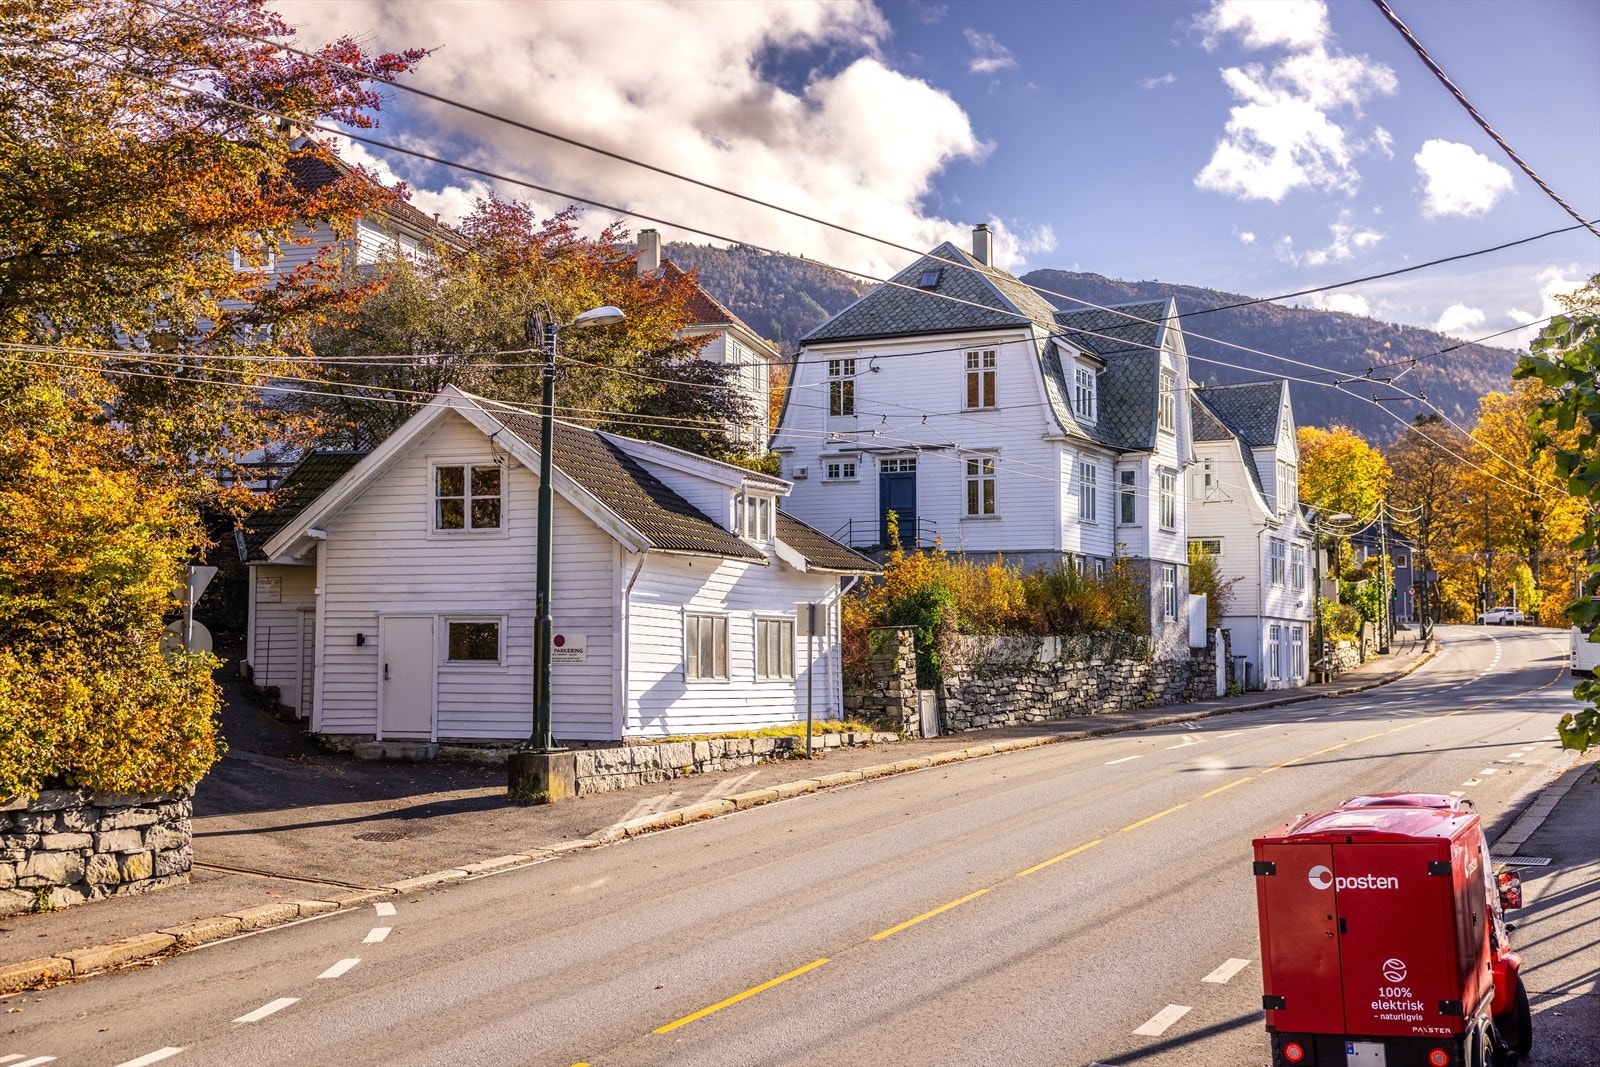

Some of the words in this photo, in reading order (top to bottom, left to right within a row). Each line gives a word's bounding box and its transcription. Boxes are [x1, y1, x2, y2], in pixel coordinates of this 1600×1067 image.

[1335, 873, 1399, 892] posten
[1379, 987, 1412, 998] 100%
[1371, 999, 1424, 1011] elektrisk
[1380, 1013, 1423, 1022] naturligvis
[1412, 1026, 1451, 1034] PAXSTER
